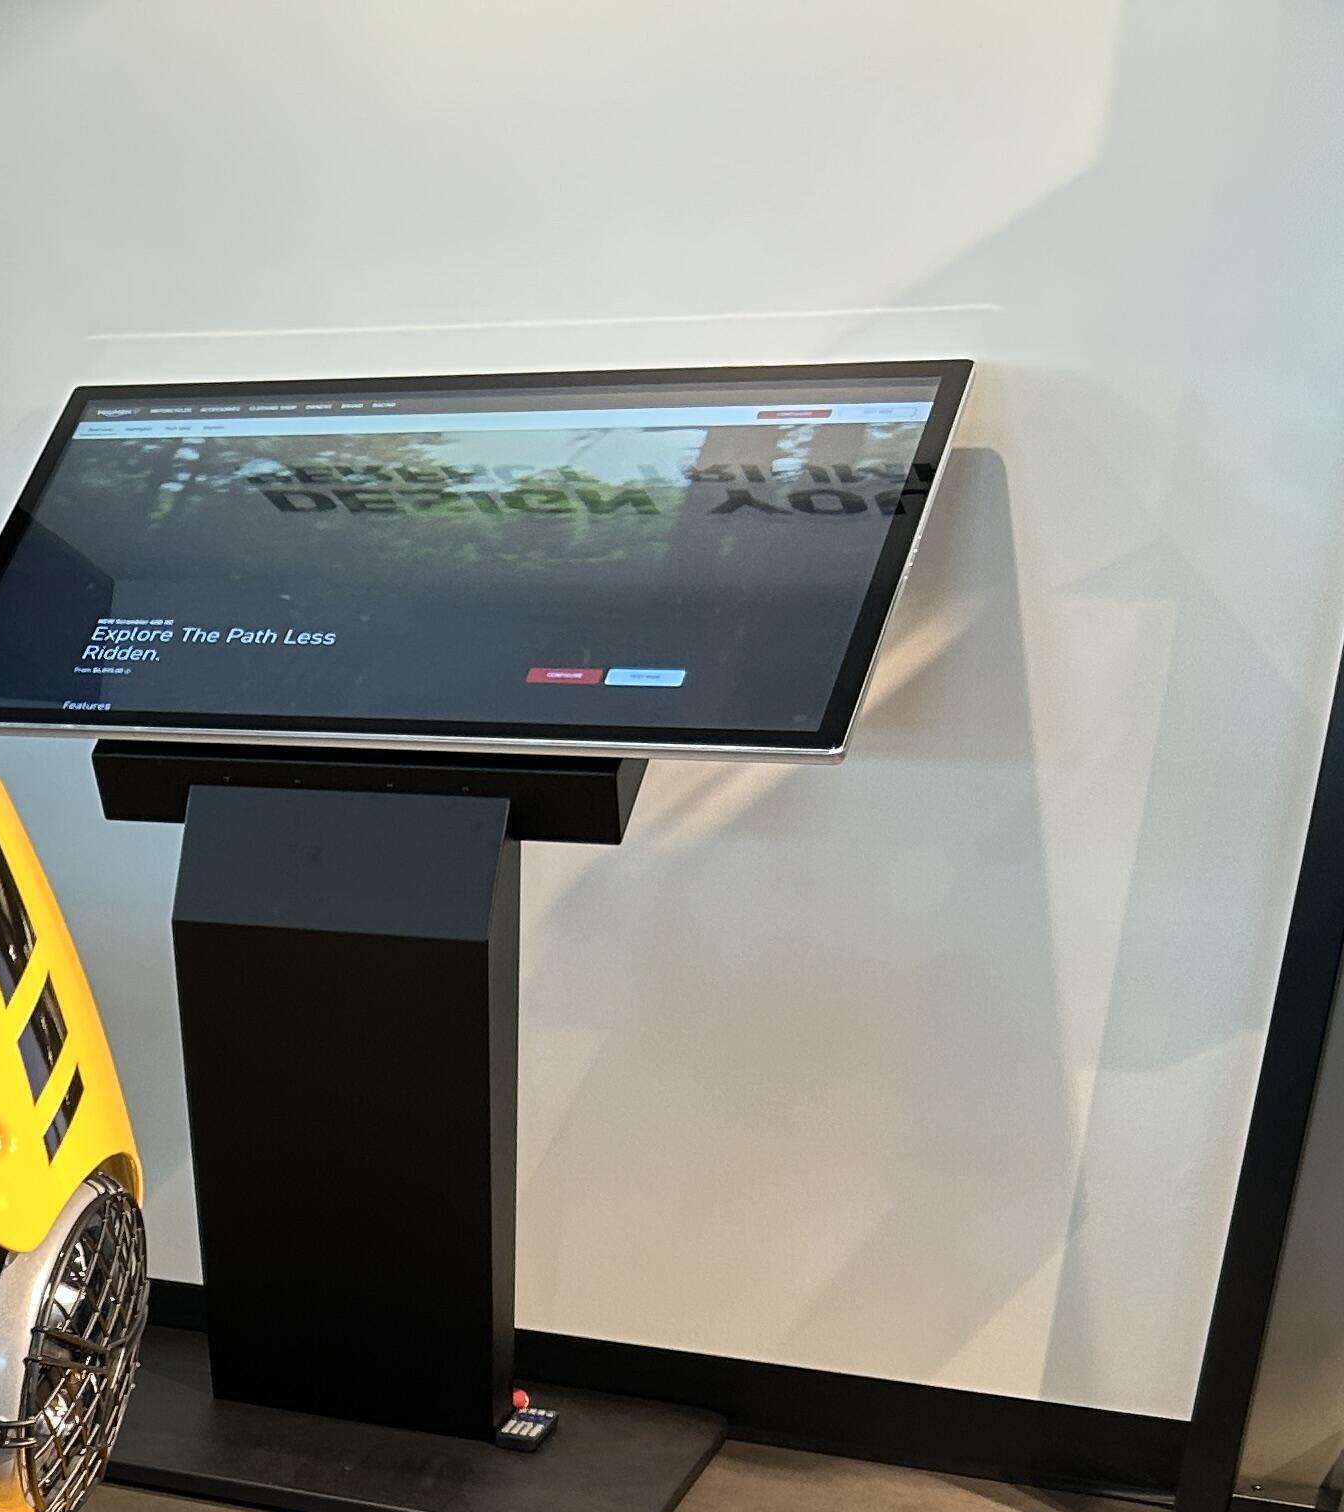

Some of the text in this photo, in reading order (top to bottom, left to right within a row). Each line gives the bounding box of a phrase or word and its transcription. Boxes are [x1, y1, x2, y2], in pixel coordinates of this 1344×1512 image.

[91, 626, 337, 646] Explore The Path Less
[81, 645, 160, 662] Ridden.
[62, 700, 111, 711] Features
